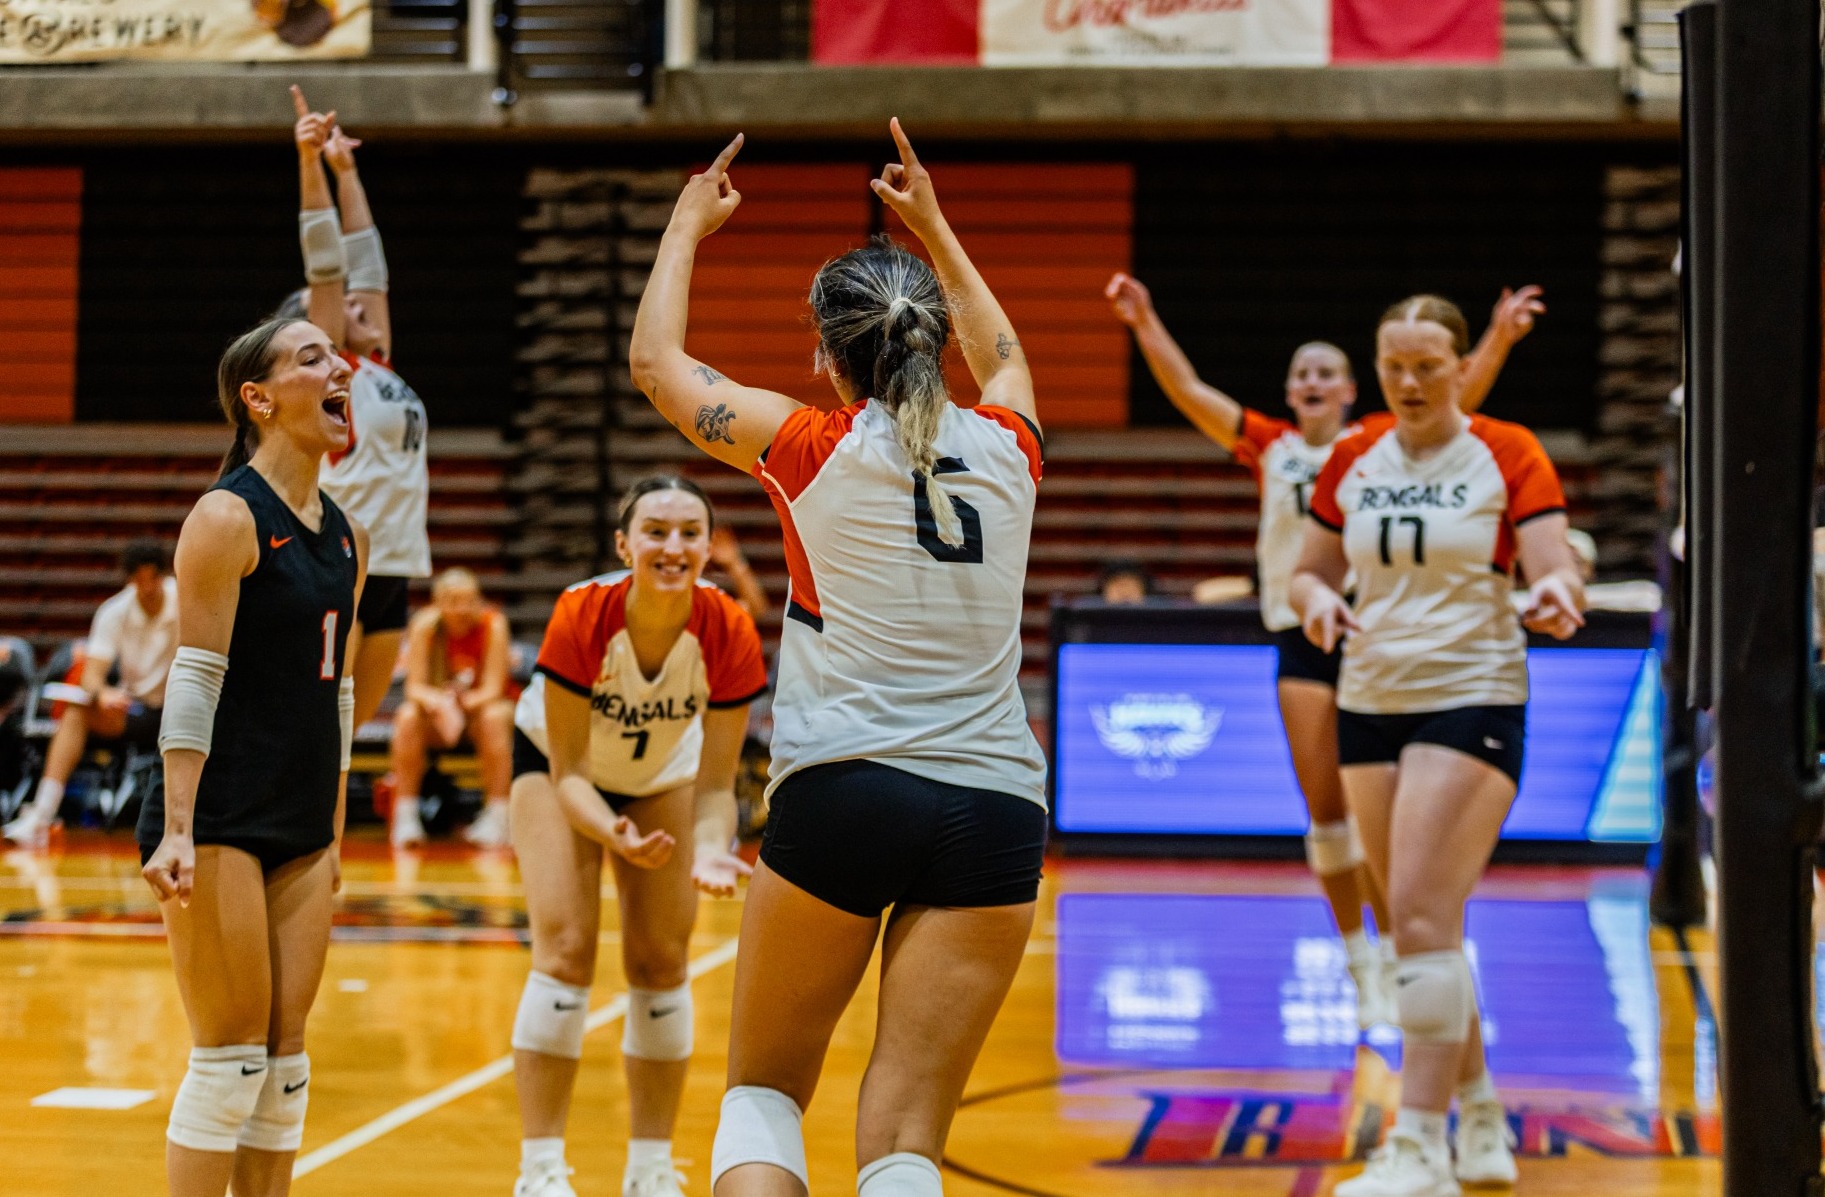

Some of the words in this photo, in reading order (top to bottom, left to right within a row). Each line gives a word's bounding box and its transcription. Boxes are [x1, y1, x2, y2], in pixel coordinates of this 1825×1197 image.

[911, 456, 984, 564] 6
[1380, 516, 1424, 566] 17
[319, 609, 339, 681] 1
[621, 729, 650, 761] 7
